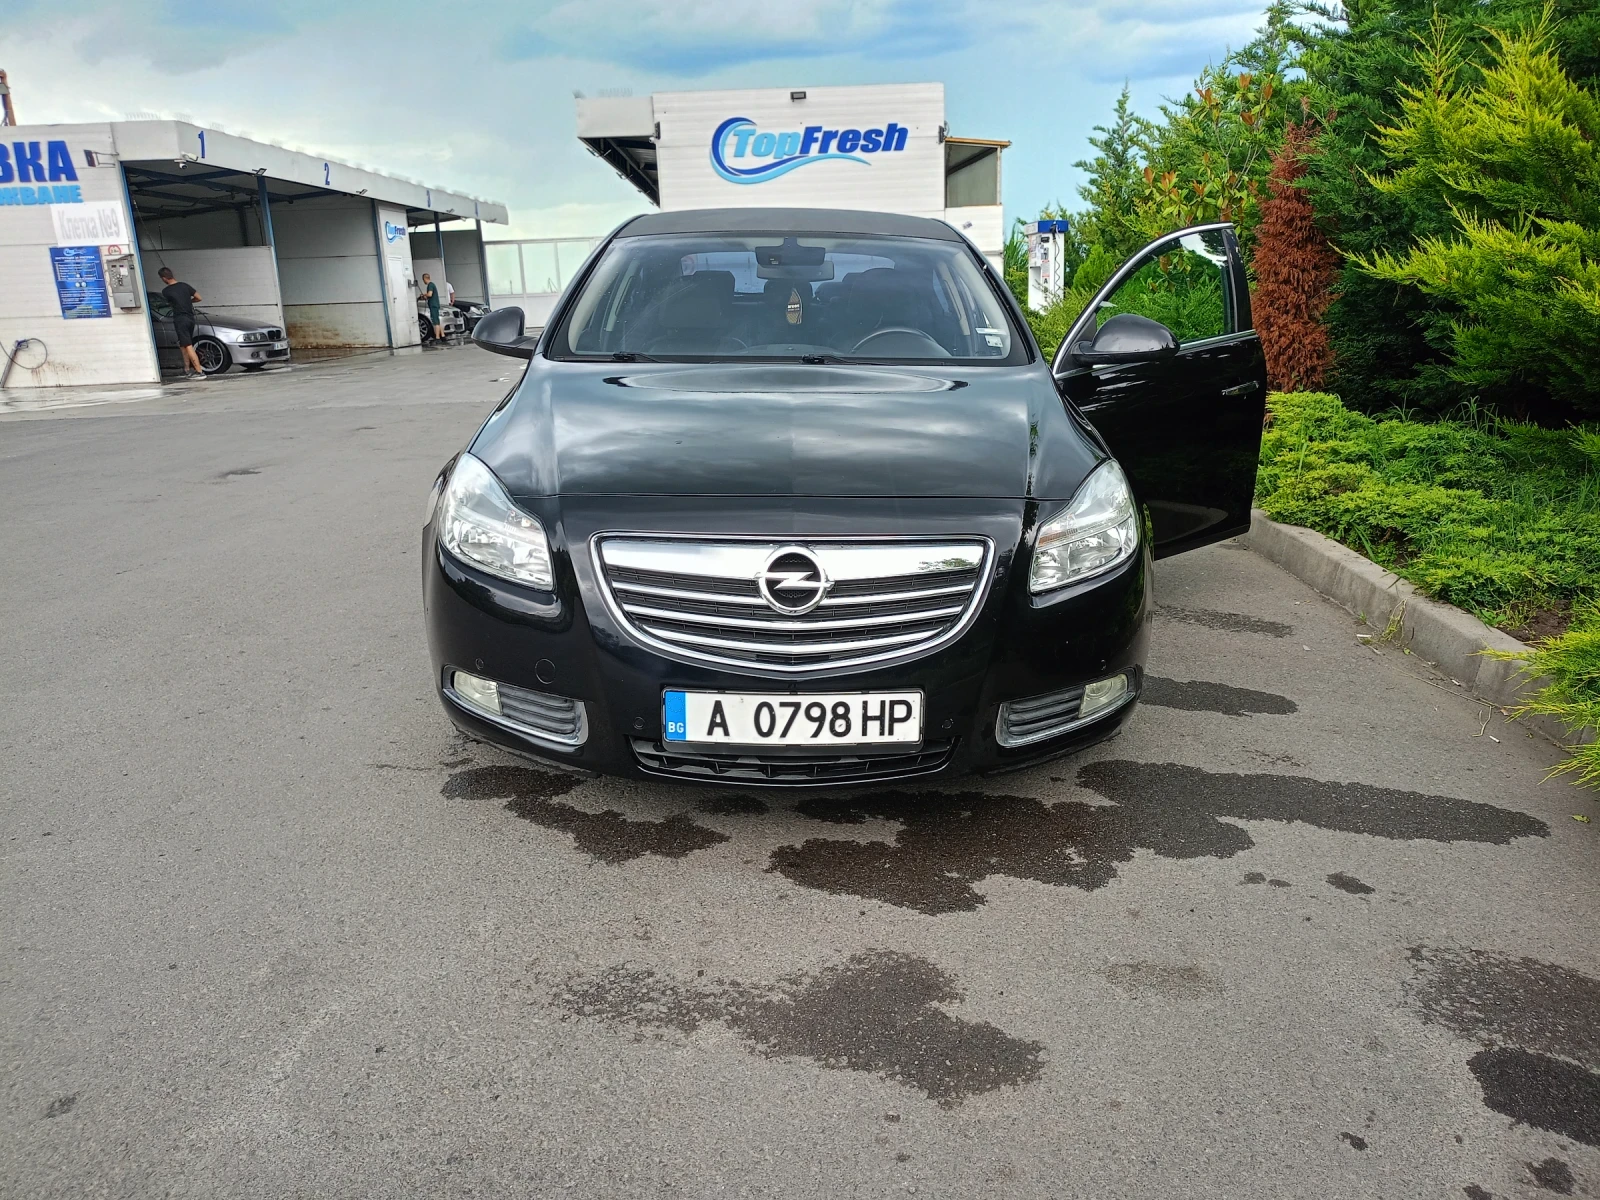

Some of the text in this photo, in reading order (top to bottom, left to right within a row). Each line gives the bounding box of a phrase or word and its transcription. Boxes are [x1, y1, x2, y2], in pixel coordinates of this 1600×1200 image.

[198, 130, 206, 159] 1
[733, 122, 909, 159] TopFresh
[324, 162, 330, 186] 2
[58, 210, 99, 240] Клетка
[668, 721, 684, 734] BG
[706, 700, 913, 738] A 0798 HP
